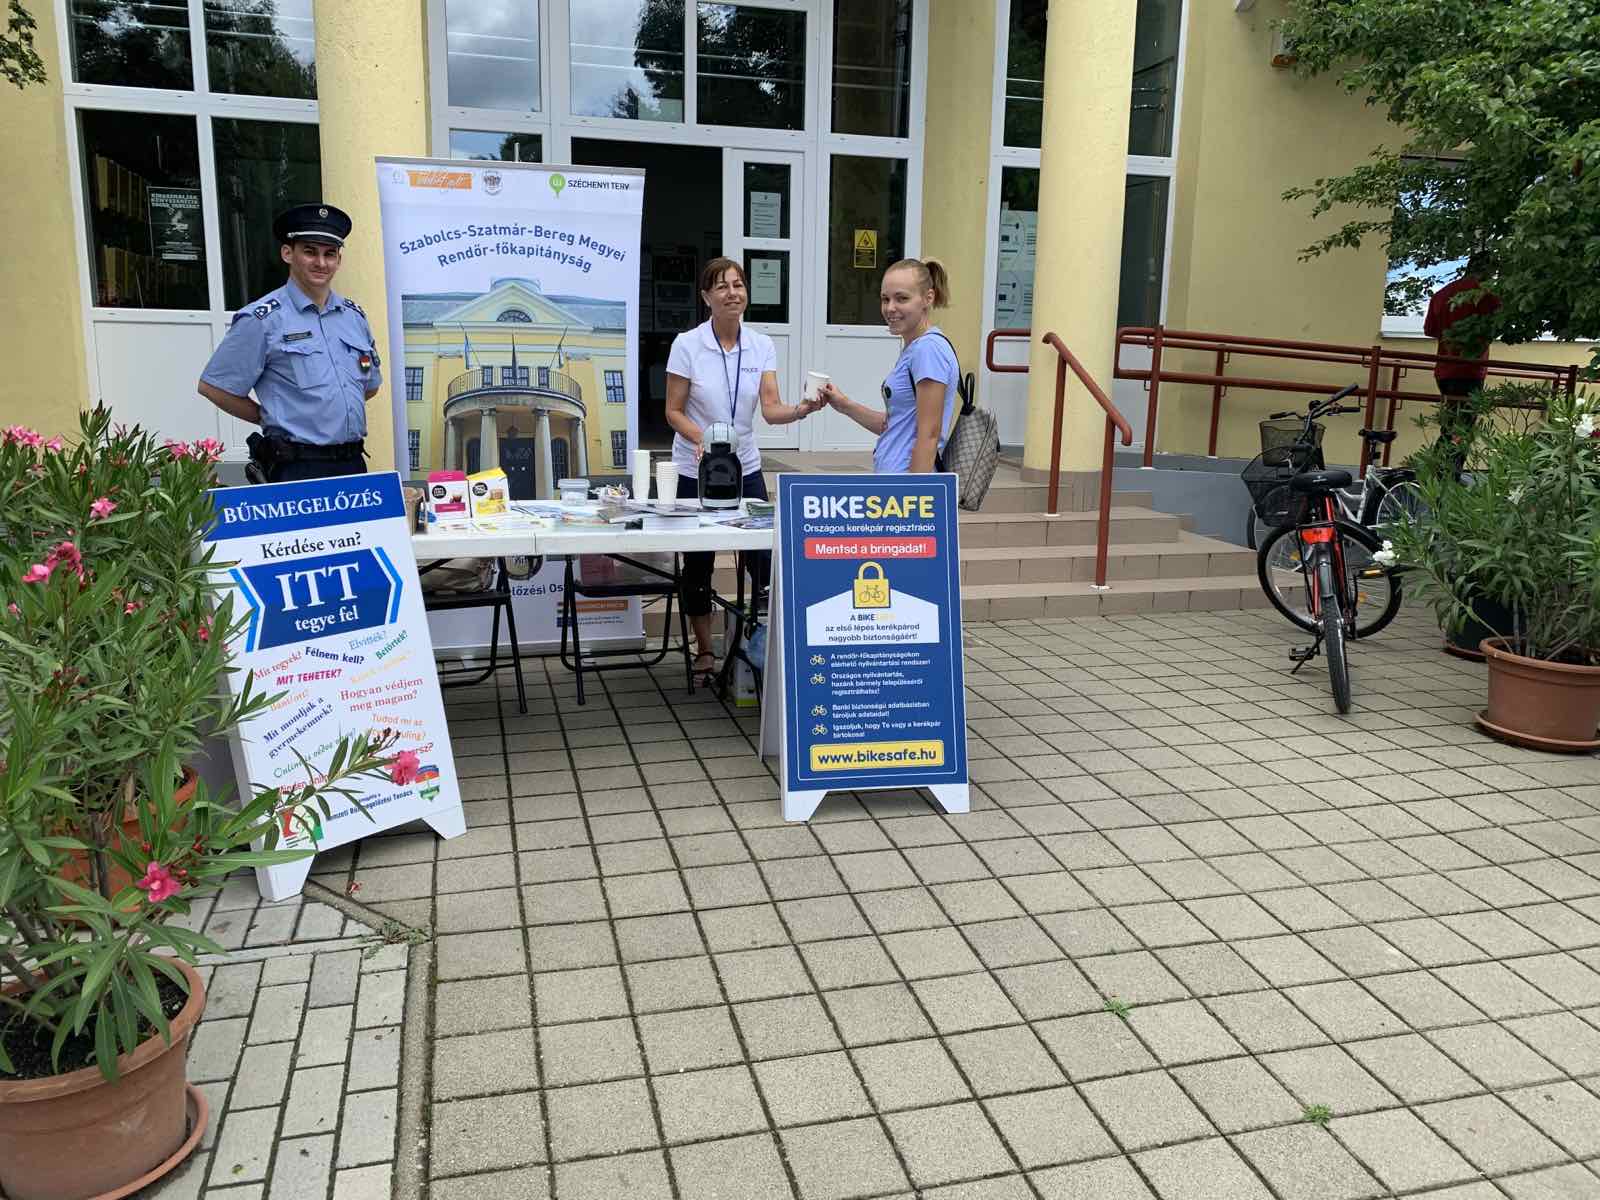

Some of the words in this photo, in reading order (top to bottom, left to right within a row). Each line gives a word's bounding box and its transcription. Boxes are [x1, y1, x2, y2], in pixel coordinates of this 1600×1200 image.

[568, 178, 610, 190] SZÉCHENYI
[611, 182, 630, 190] TERV
[400, 223, 575, 256] Szabolcs-Szatmár-Bereg
[578, 234, 627, 262] Megyei
[438, 241, 592, 273] Rendőr-főkapitányság
[223, 488, 383, 524] BŰNMEGELŐZÉS
[803, 496, 936, 518] BIKESAFE
[804, 524, 845, 534] Országos
[846, 524, 884, 534] kerékpár
[886, 523, 936, 534] regisztráció
[261, 538, 326, 560] Kérdése
[330, 532, 362, 549] van?
[815, 543, 858, 555] Mentsd
[860, 546, 868, 554] a
[275, 562, 360, 612] ITT
[512, 584, 546, 596] lőzési
[549, 583, 564, 592] Os
[295, 614, 338, 633] tegye
[338, 604, 360, 622] fel
[836, 624, 852, 632] első
[854, 624, 874, 632] lépés
[876, 622, 920, 632] kerékpárod
[828, 634, 862, 644] nagyobb
[863, 632, 918, 642] biztonságáért!
[305, 646, 339, 662] Félnem
[342, 650, 365, 665] kell?
[254, 666, 271, 680] Mit
[276, 674, 294, 686] MIT
[298, 668, 343, 682] TEHETEK?
[832, 672, 861, 680] Országos
[340, 684, 382, 702] Hogyan
[386, 678, 424, 694] védjem
[350, 699, 373, 712] meg
[375, 690, 418, 707] magam?
[262, 726, 280, 744] Mit
[864, 722, 881, 730] hogy
[818, 748, 936, 764] www.bikesafe.hu
